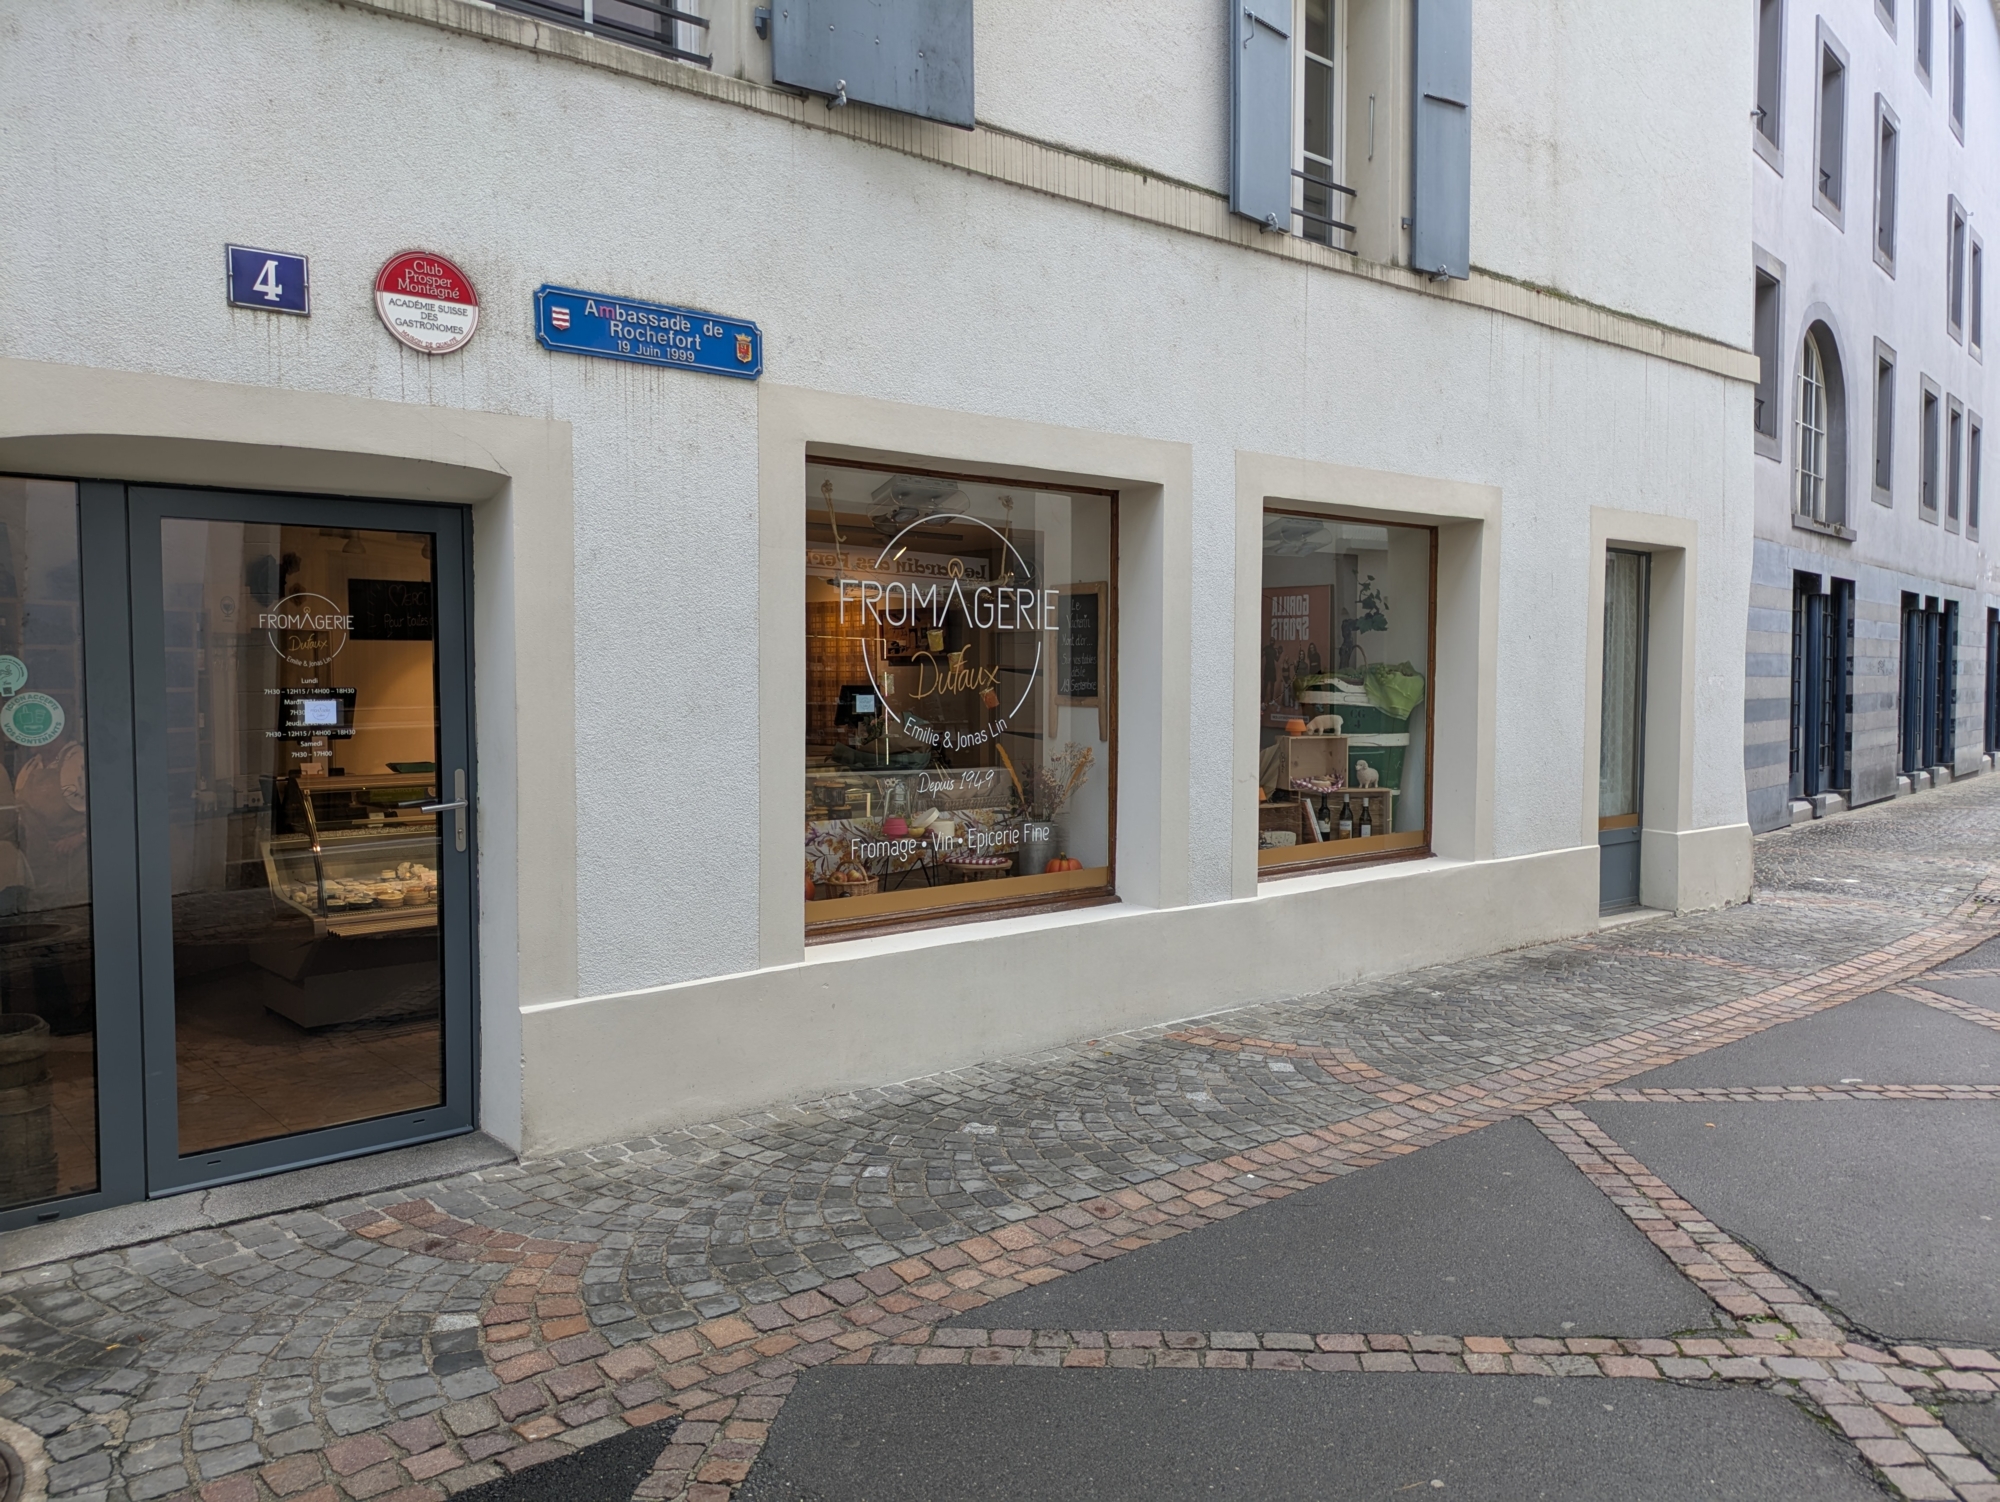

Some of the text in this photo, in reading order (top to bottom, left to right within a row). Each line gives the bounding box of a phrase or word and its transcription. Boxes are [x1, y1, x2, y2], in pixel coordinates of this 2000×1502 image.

[405, 269, 452, 288] Prosper
[413, 260, 443, 276] Club
[252, 259, 284, 303] 4
[397, 278, 459, 300] Montagné
[388, 298, 468, 317] ACADÉMIE SUISSE
[420, 312, 438, 321] DES
[395, 317, 464, 335] GASTRONOMES
[584, 300, 723, 338] Ambassade de
[401, 329, 423, 346] MAISON
[610, 321, 702, 350] Rochefort
[617, 340, 695, 363] 19 Juin 1999
[839, 577, 1060, 631] FROMAGERIE
[259, 613, 355, 630] FROMAGERIE
[288, 633, 328, 651] Dufaux
[286, 655, 302, 666] Emilie
[308, 659, 323, 668] Jonas
[322, 656, 332, 665] Lin
[909, 644, 1001, 700] Dufaux
[5, 700, 16, 712] ICI
[14, 695, 26, 705] ON
[27, 694, 59, 711] ACCEPTE
[4, 722, 62, 745] VOS CONTENANTS
[903, 716, 1008, 751] Emilie & Jonas Lin
[917, 769, 995, 798] Depuis 1949
[851, 838, 916, 862] Fromage
[932, 831, 953, 852] Vin
[968, 826, 1020, 853] Epicerie
[1023, 823, 1050, 843] Fine
